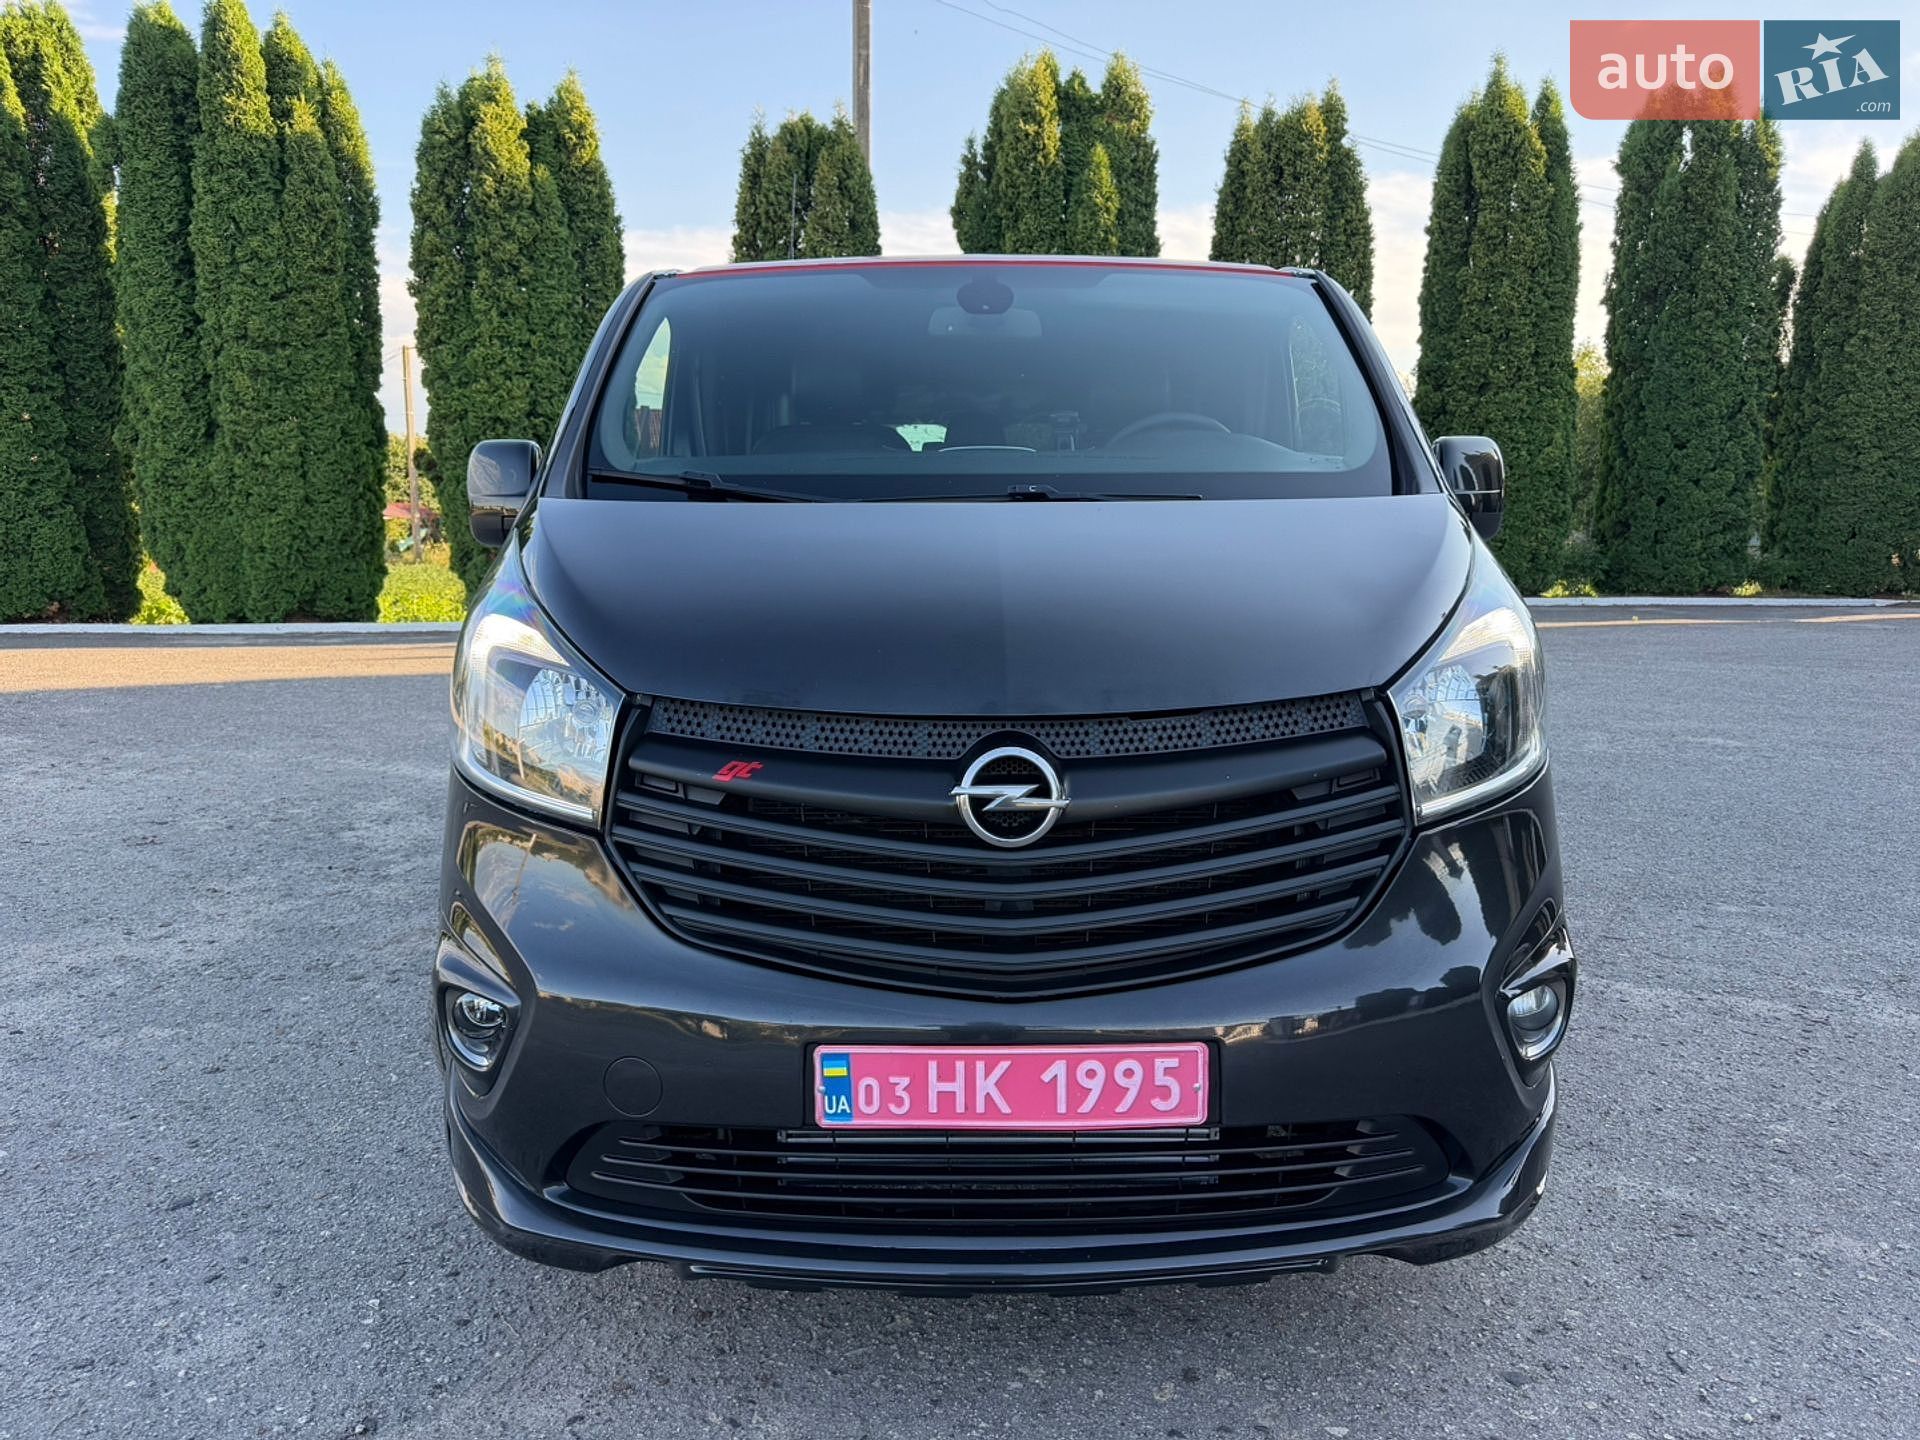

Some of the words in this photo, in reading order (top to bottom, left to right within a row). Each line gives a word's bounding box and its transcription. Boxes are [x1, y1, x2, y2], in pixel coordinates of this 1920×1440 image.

[823, 1095, 851, 1114] UA
[857, 1076, 911, 1116] 03
[926, 1059, 1012, 1114] HK
[1039, 1058, 1182, 1115] 1995
